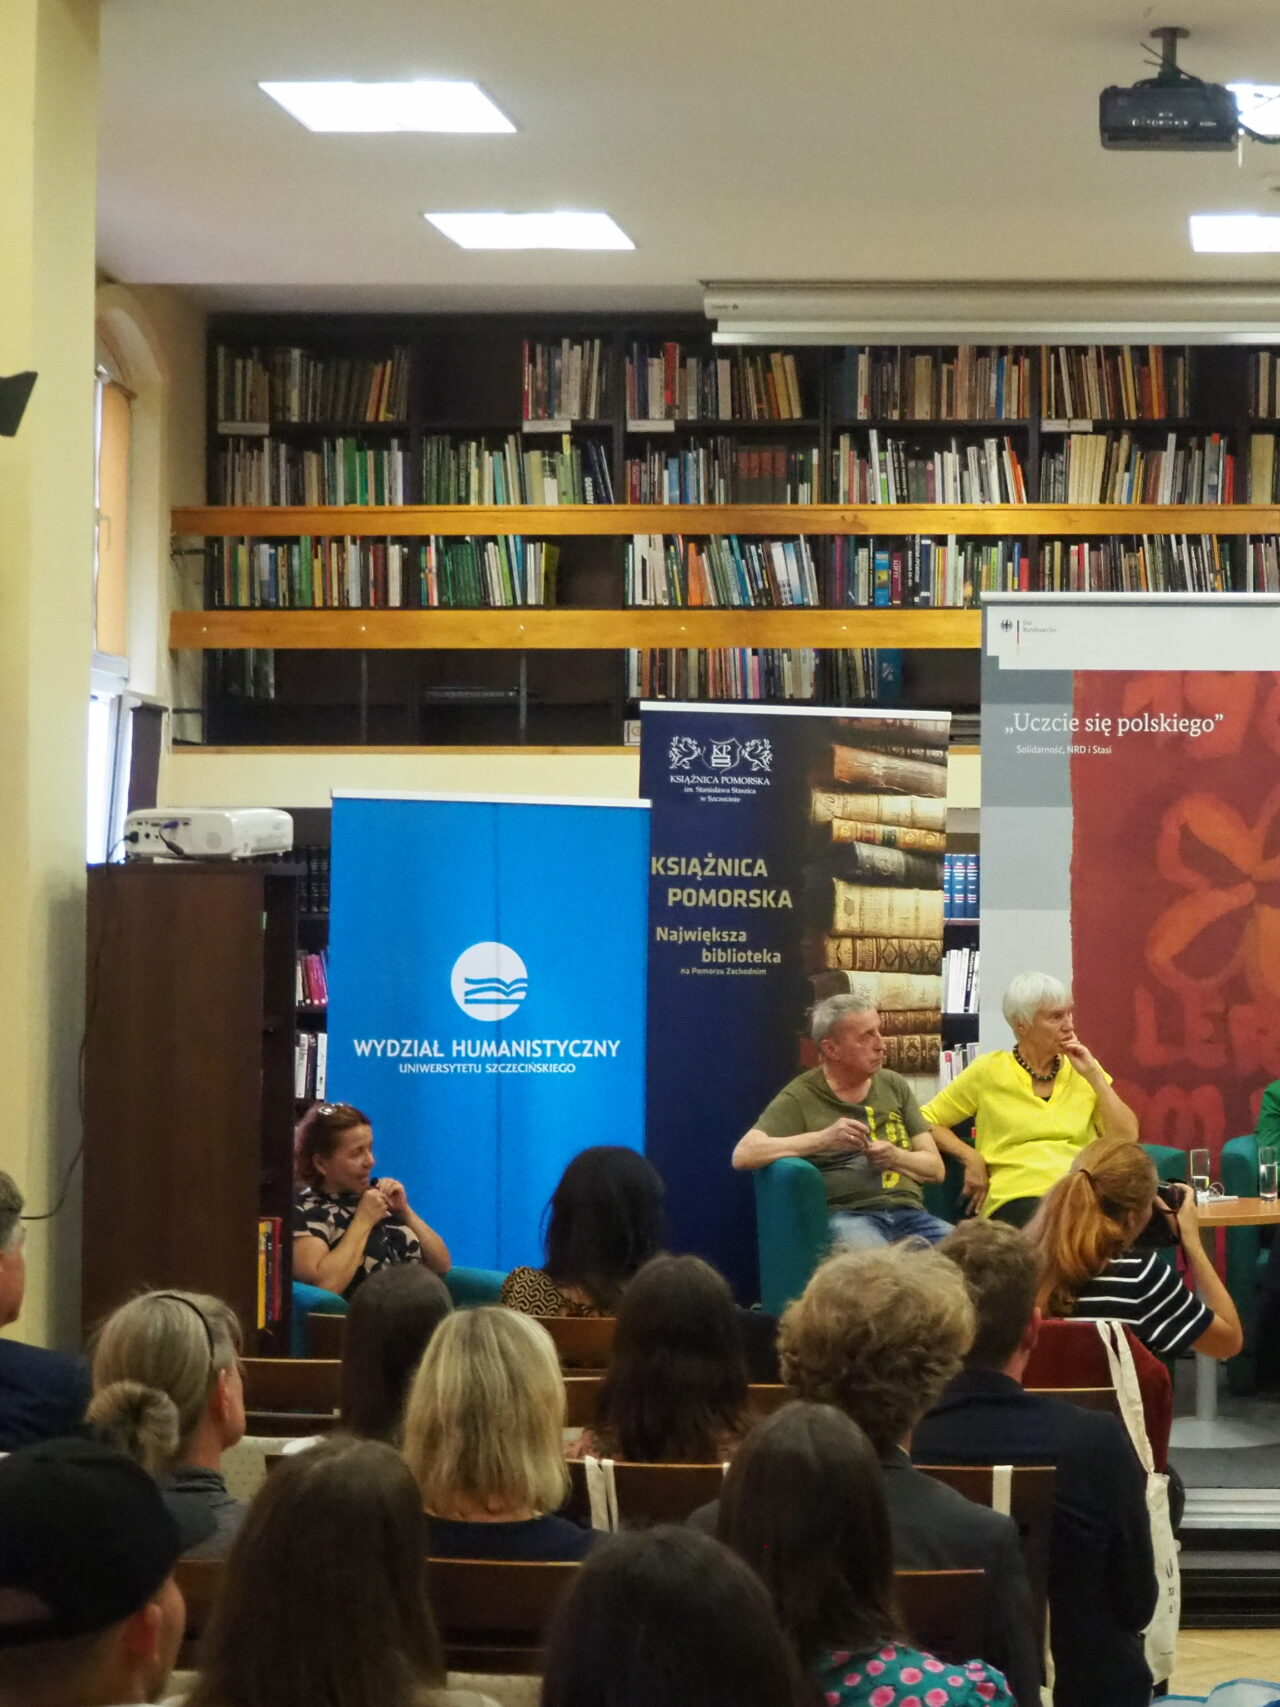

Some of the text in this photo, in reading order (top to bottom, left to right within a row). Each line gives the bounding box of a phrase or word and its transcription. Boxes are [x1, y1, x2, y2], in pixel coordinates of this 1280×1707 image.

[1005, 712, 1224, 737] „Uczcie się polskiego”
[713, 745, 731, 755] KP
[1016, 744, 1065, 756] Solidarność,
[1067, 745, 1087, 754] NRD
[1092, 745, 1112, 754] Stasi
[670, 774, 770, 785] KSIĄŻNICA POMORSKA
[651, 852, 768, 880] KSIĄŻNICA
[668, 888, 793, 908] POMORSKA
[656, 926, 747, 945] Największa
[702, 948, 781, 963] biblioteka
[353, 1039, 621, 1058] WYDZIAŁ HUMANISTYCZNY
[399, 1061, 576, 1074] UNIWERSYTETU SZCZECIŃSKIEGO
